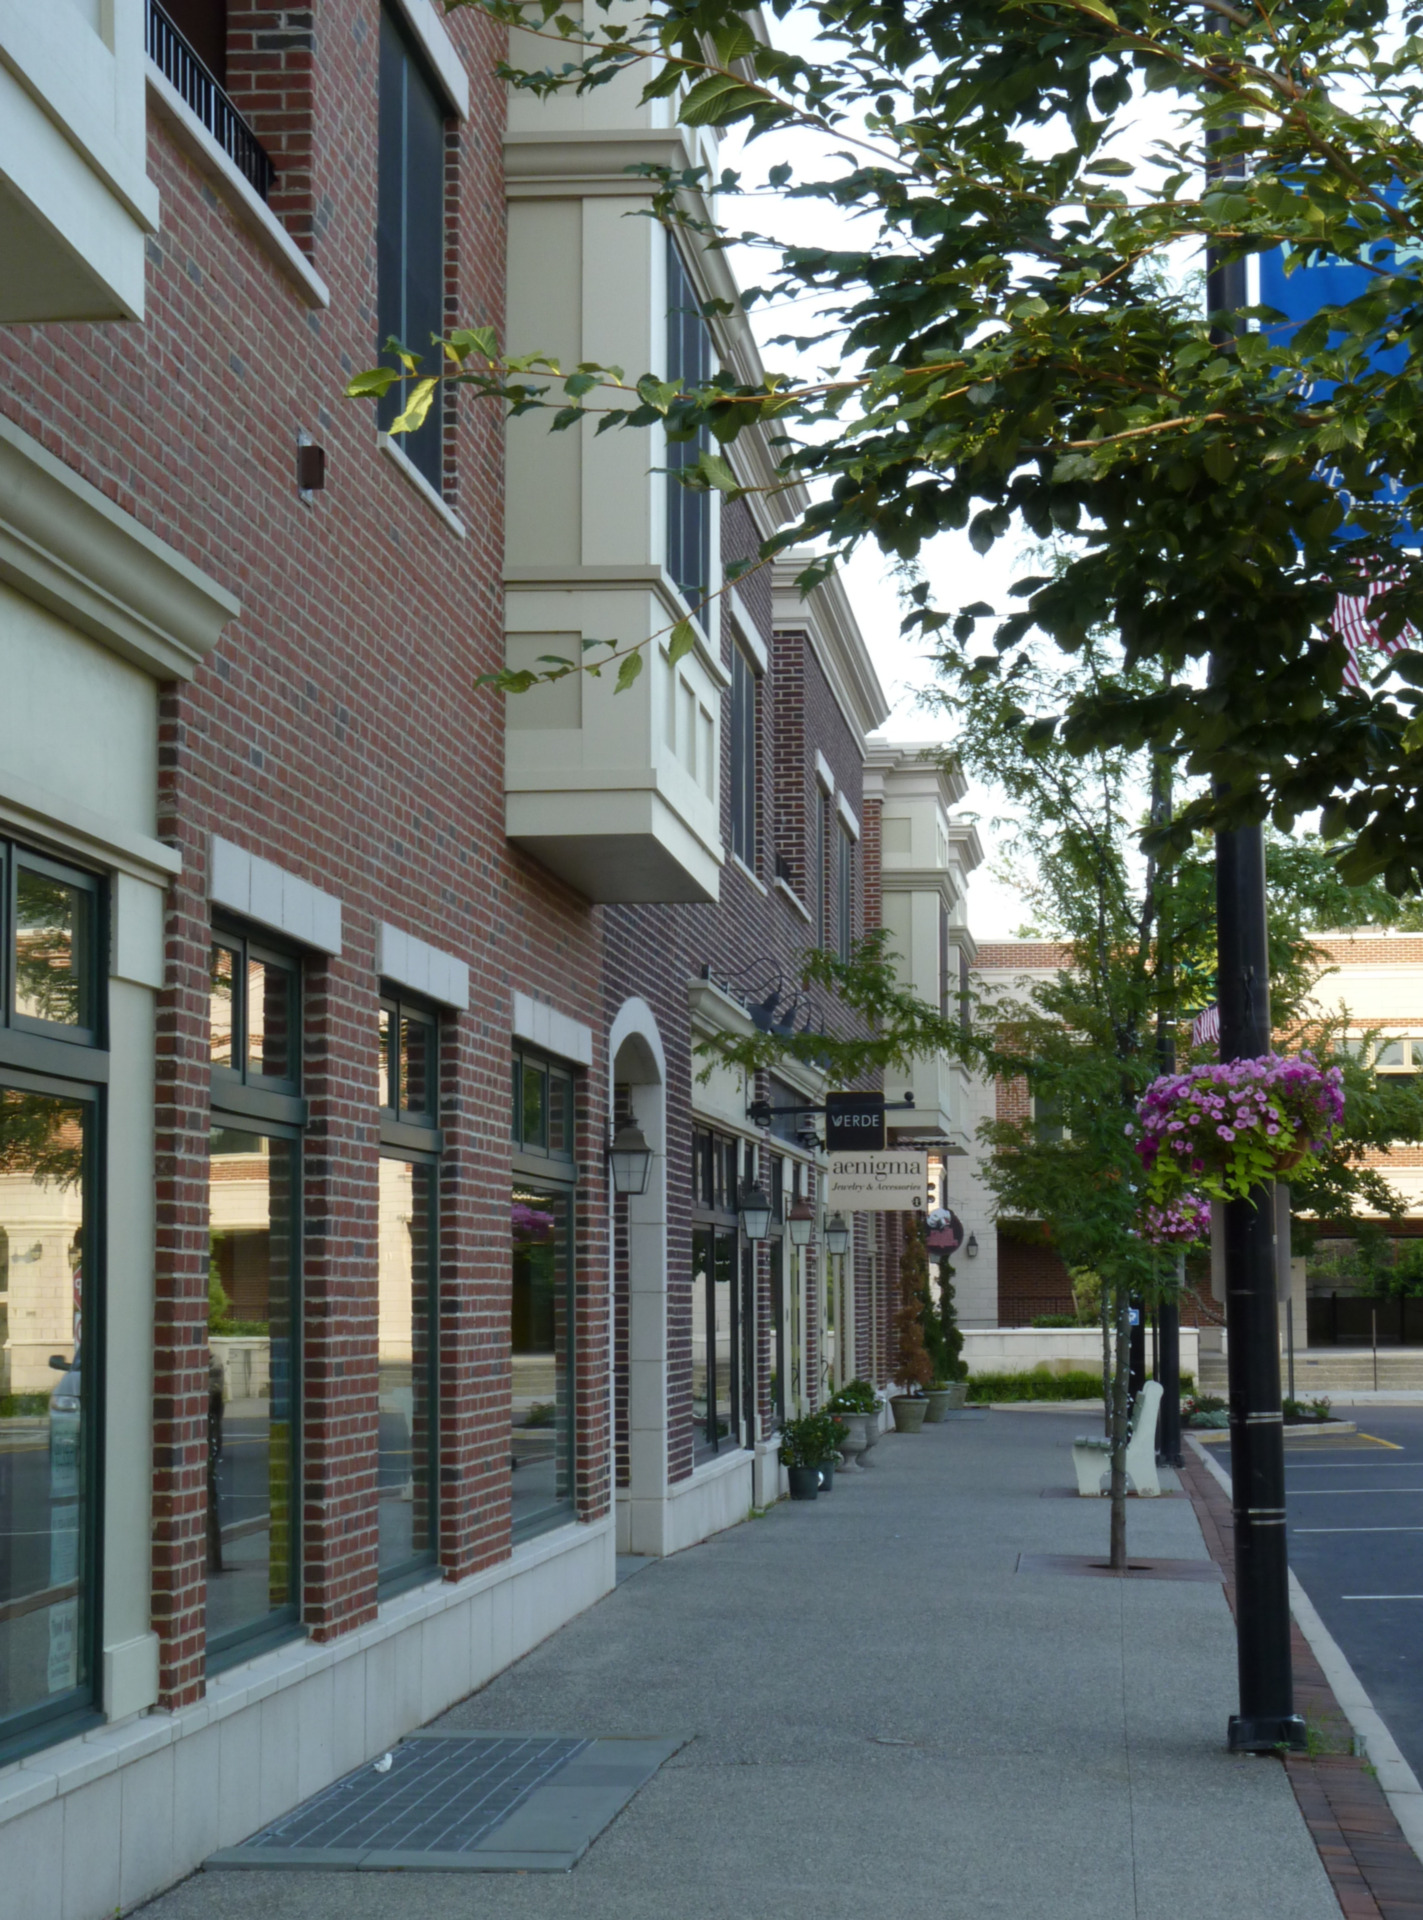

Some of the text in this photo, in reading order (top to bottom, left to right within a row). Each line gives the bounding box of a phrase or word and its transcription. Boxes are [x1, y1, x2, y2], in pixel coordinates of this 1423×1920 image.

[832, 1115, 880, 1127] VERDE
[832, 1156, 921, 1181] aenigma
[831, 1183, 921, 1193] Jewelry & Accessories
